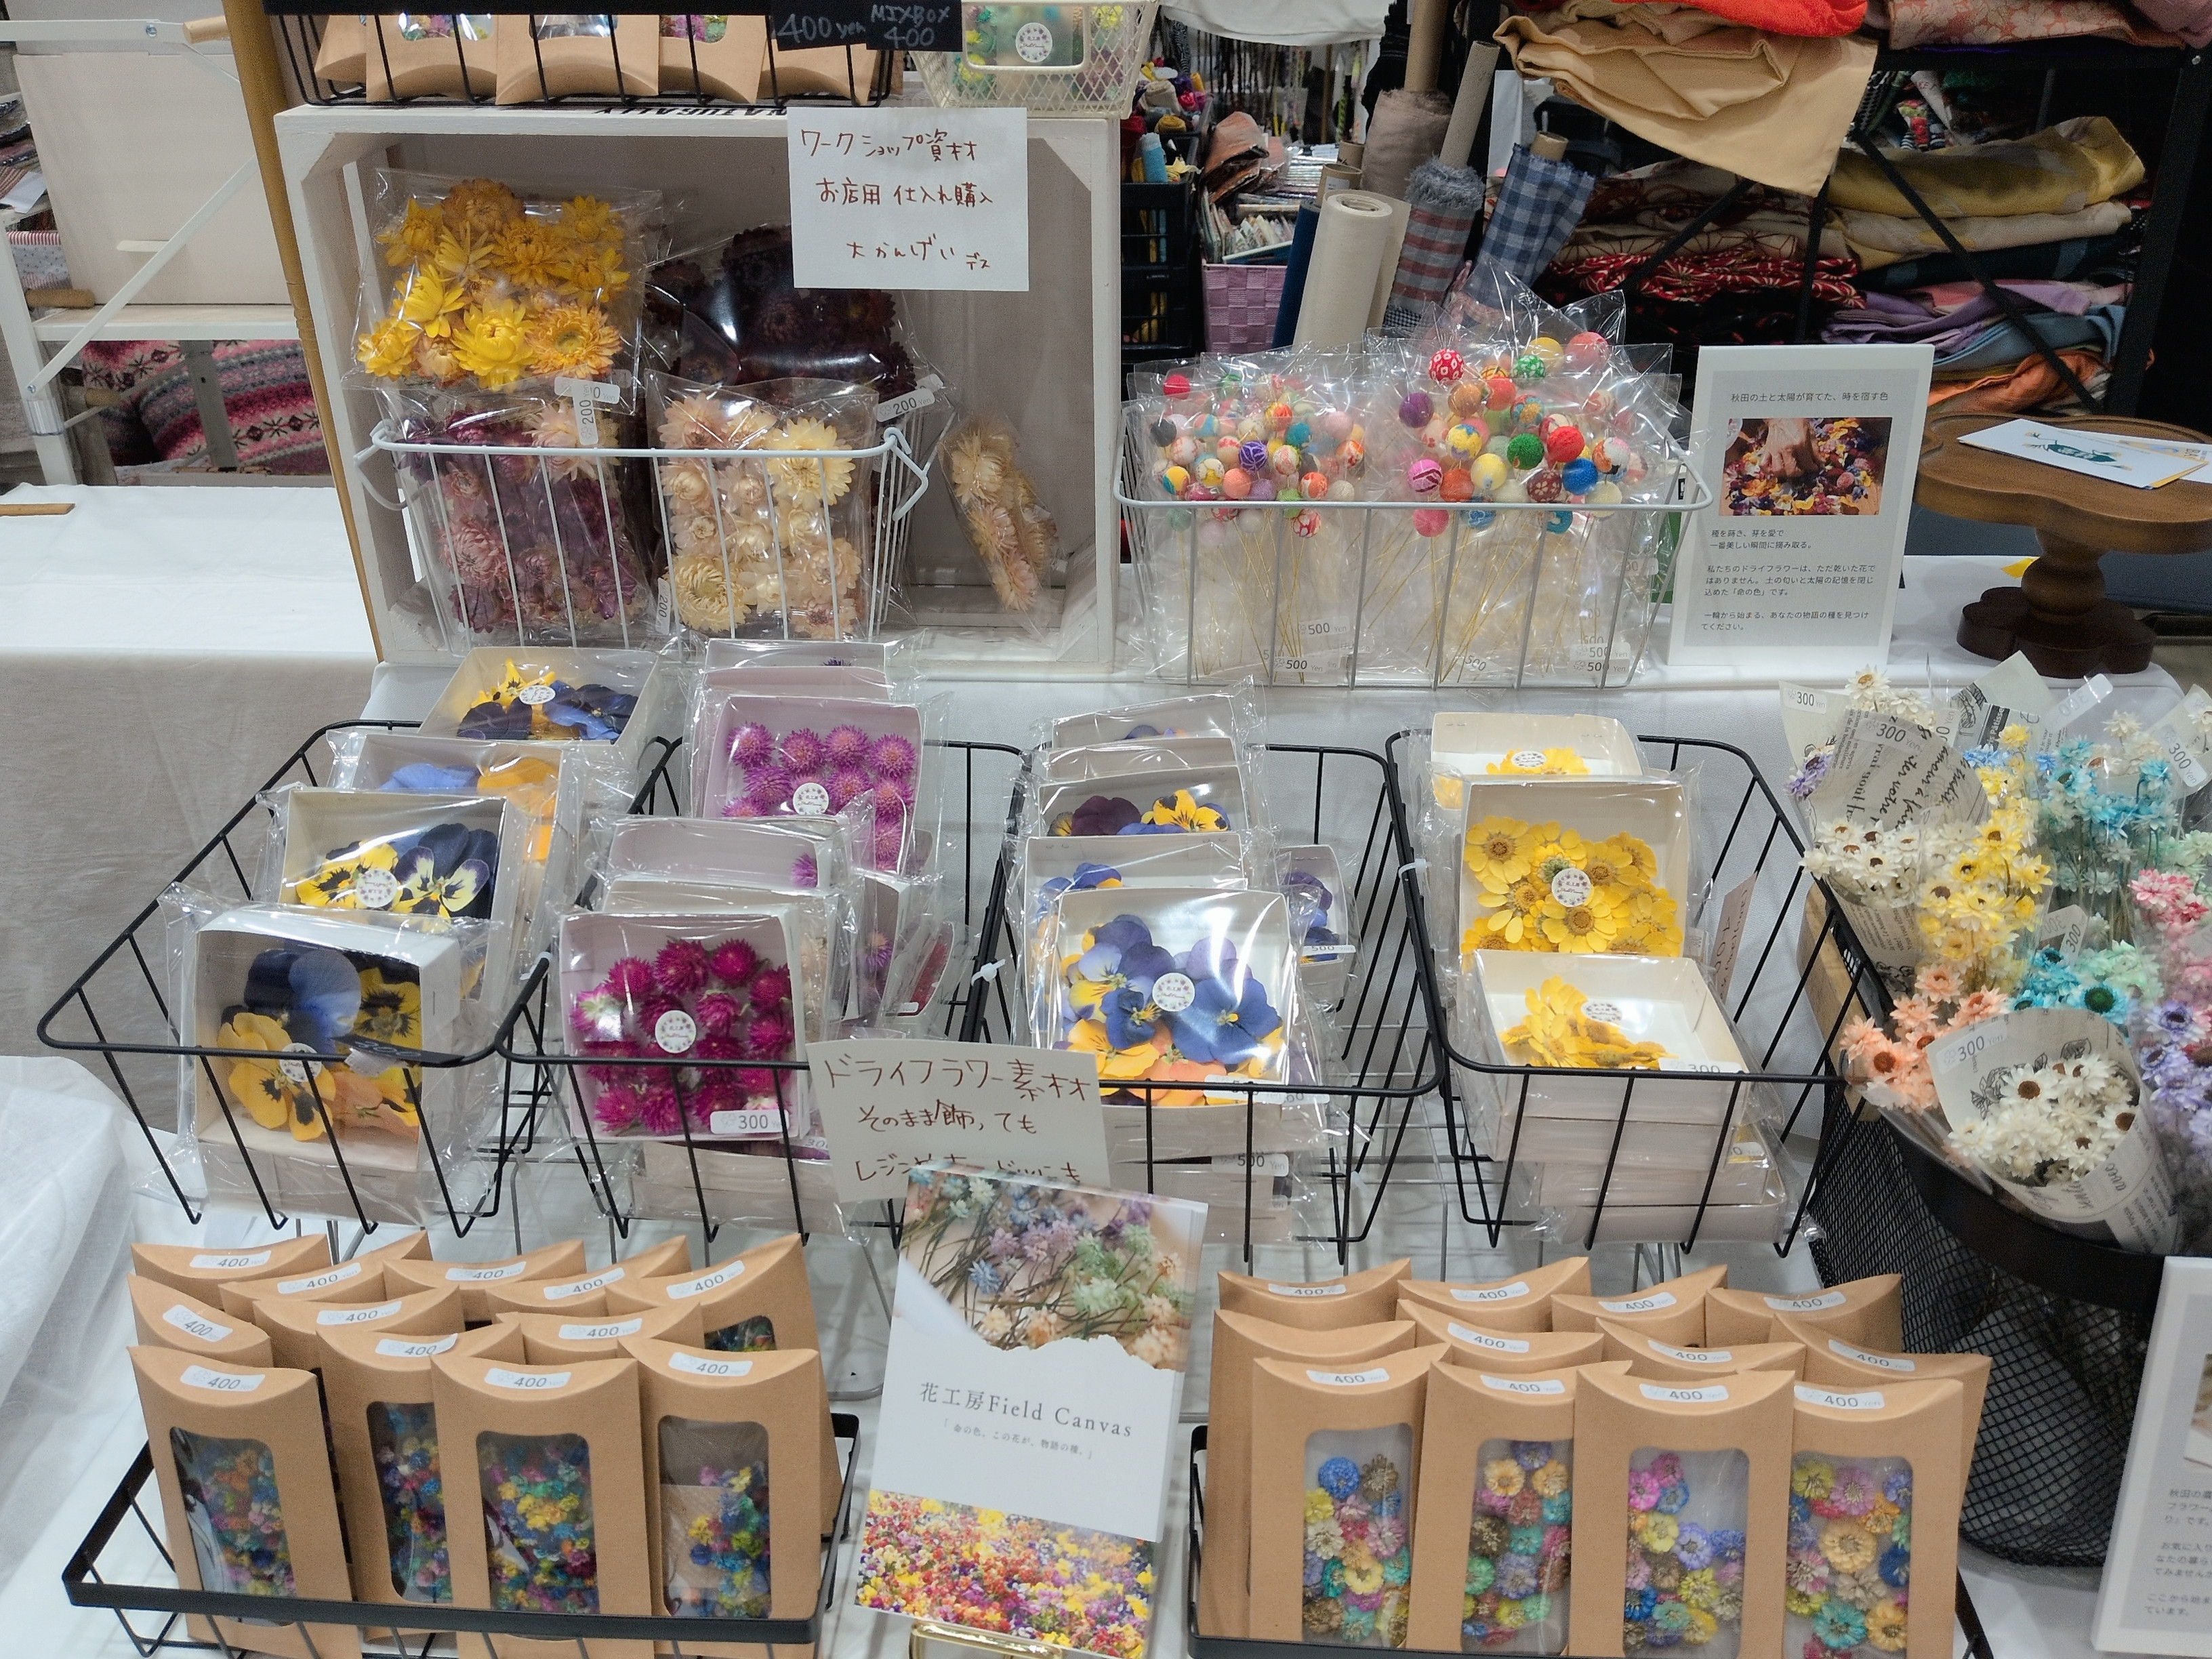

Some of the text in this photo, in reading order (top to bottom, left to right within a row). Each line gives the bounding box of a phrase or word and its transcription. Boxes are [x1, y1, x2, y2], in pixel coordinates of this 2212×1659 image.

[777, 14, 832, 43] 400
[884, 26, 935, 49] 400
[800, 128, 977, 162] ワークショップ資材
[815, 177, 993, 207] お店用 仕入れ購入
[579, 400, 594, 424] 200
[893, 397, 917, 415] 200
[1308, 623, 1330, 634] 500
[1701, 622, 1744, 631] てください。
[1286, 659, 1308, 670] 500
[1797, 691, 1814, 706] 300
[1876, 724, 1906, 743] 300
[2169, 743, 2192, 770] 300
[2065, 923, 2082, 953] 300
[1958, 1035, 1986, 1061] 300
[825, 1053, 1091, 1102] ドライフラワー素材
[738, 1115, 769, 1130] 300
[218, 1258, 249, 1267] 400
[472, 1269, 504, 1279] 400
[306, 1275, 338, 1289] 400
[572, 1279, 602, 1294] 400
[694, 1275, 724, 1292] 400
[1478, 1290, 1507, 1300] 400
[1626, 1300, 1654, 1311] 400
[1793, 1298, 1822, 1308] 400
[346, 1311, 377, 1322] 400
[184, 1320, 213, 1336] 400
[587, 1326, 618, 1337] 400
[1473, 1336, 1505, 1349] 400
[405, 1345, 436, 1356] 400
[1675, 1351, 1708, 1361] 400
[1857, 1353, 1889, 1367] 400
[697, 1362, 729, 1375] 400
[207, 1376, 241, 1389] 400
[513, 1377, 546, 1388] 400
[1335, 1374, 1366, 1384] 400
[1509, 1382, 1540, 1392] 400
[1669, 1390, 1702, 1400] 400
[1824, 1395, 1858, 1408] 400
[1054, 1407, 1132, 1437] Canvas
